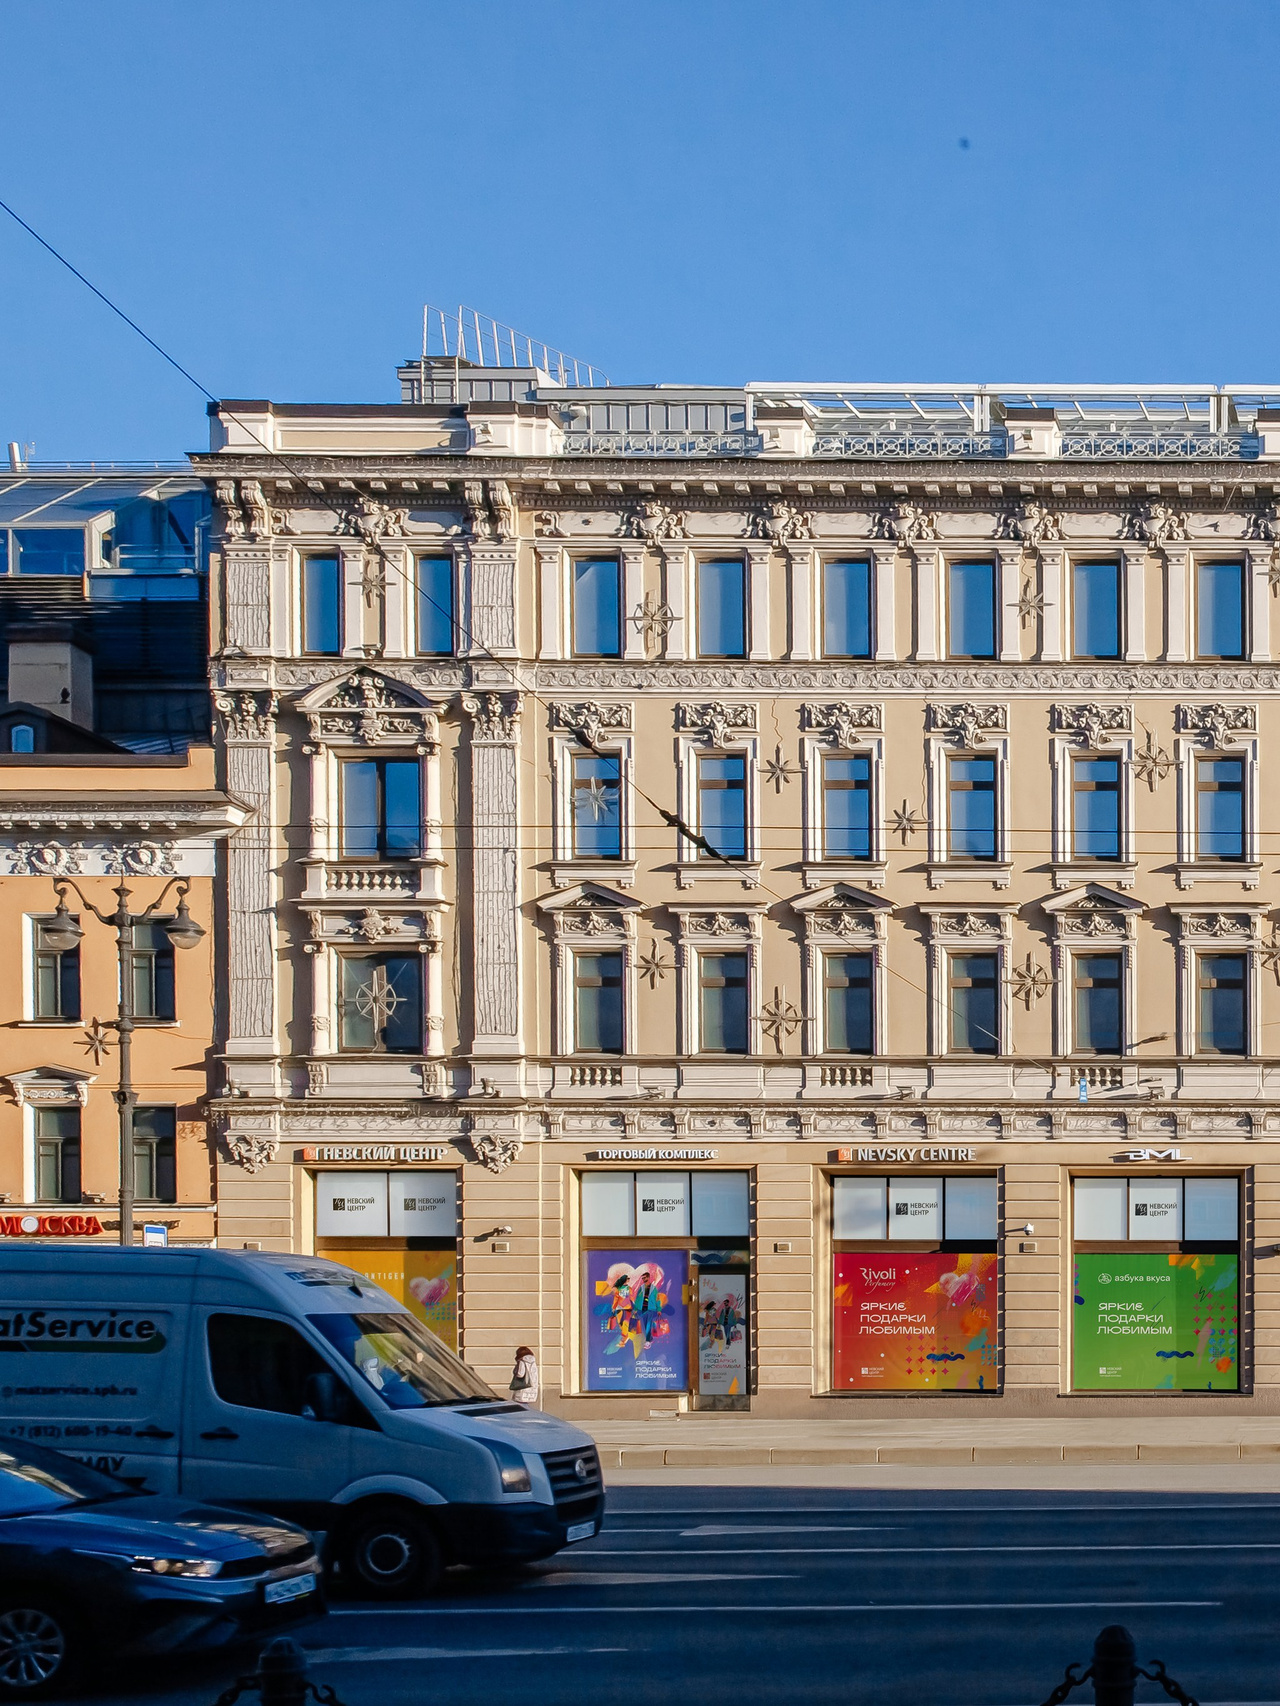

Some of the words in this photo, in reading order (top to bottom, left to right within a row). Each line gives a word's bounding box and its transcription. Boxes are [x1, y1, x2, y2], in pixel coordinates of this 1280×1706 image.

[323, 1145, 395, 1160] НЕВСКИЙ
[400, 1146, 449, 1162] ЦЕНТР
[596, 1148, 657, 1159] ТОРГОВЫЙ
[658, 1149, 719, 1159] КОМПЛЕКС
[858, 1148, 917, 1161] NEVSKY
[920, 1148, 977, 1161] CENTRE
[860, 1267, 896, 1280] Rivoli
[1114, 1273, 1144, 1283] азбука
[1146, 1275, 1171, 1283] вкуса
[860, 1314, 926, 1323] ПОДАРКИ
[1098, 1314, 1164, 1323] ПОДАРКИ
[859, 1326, 935, 1334] ЛЮБИМЫМ
[1097, 1326, 1173, 1334] ЛЮБИМЫМ
